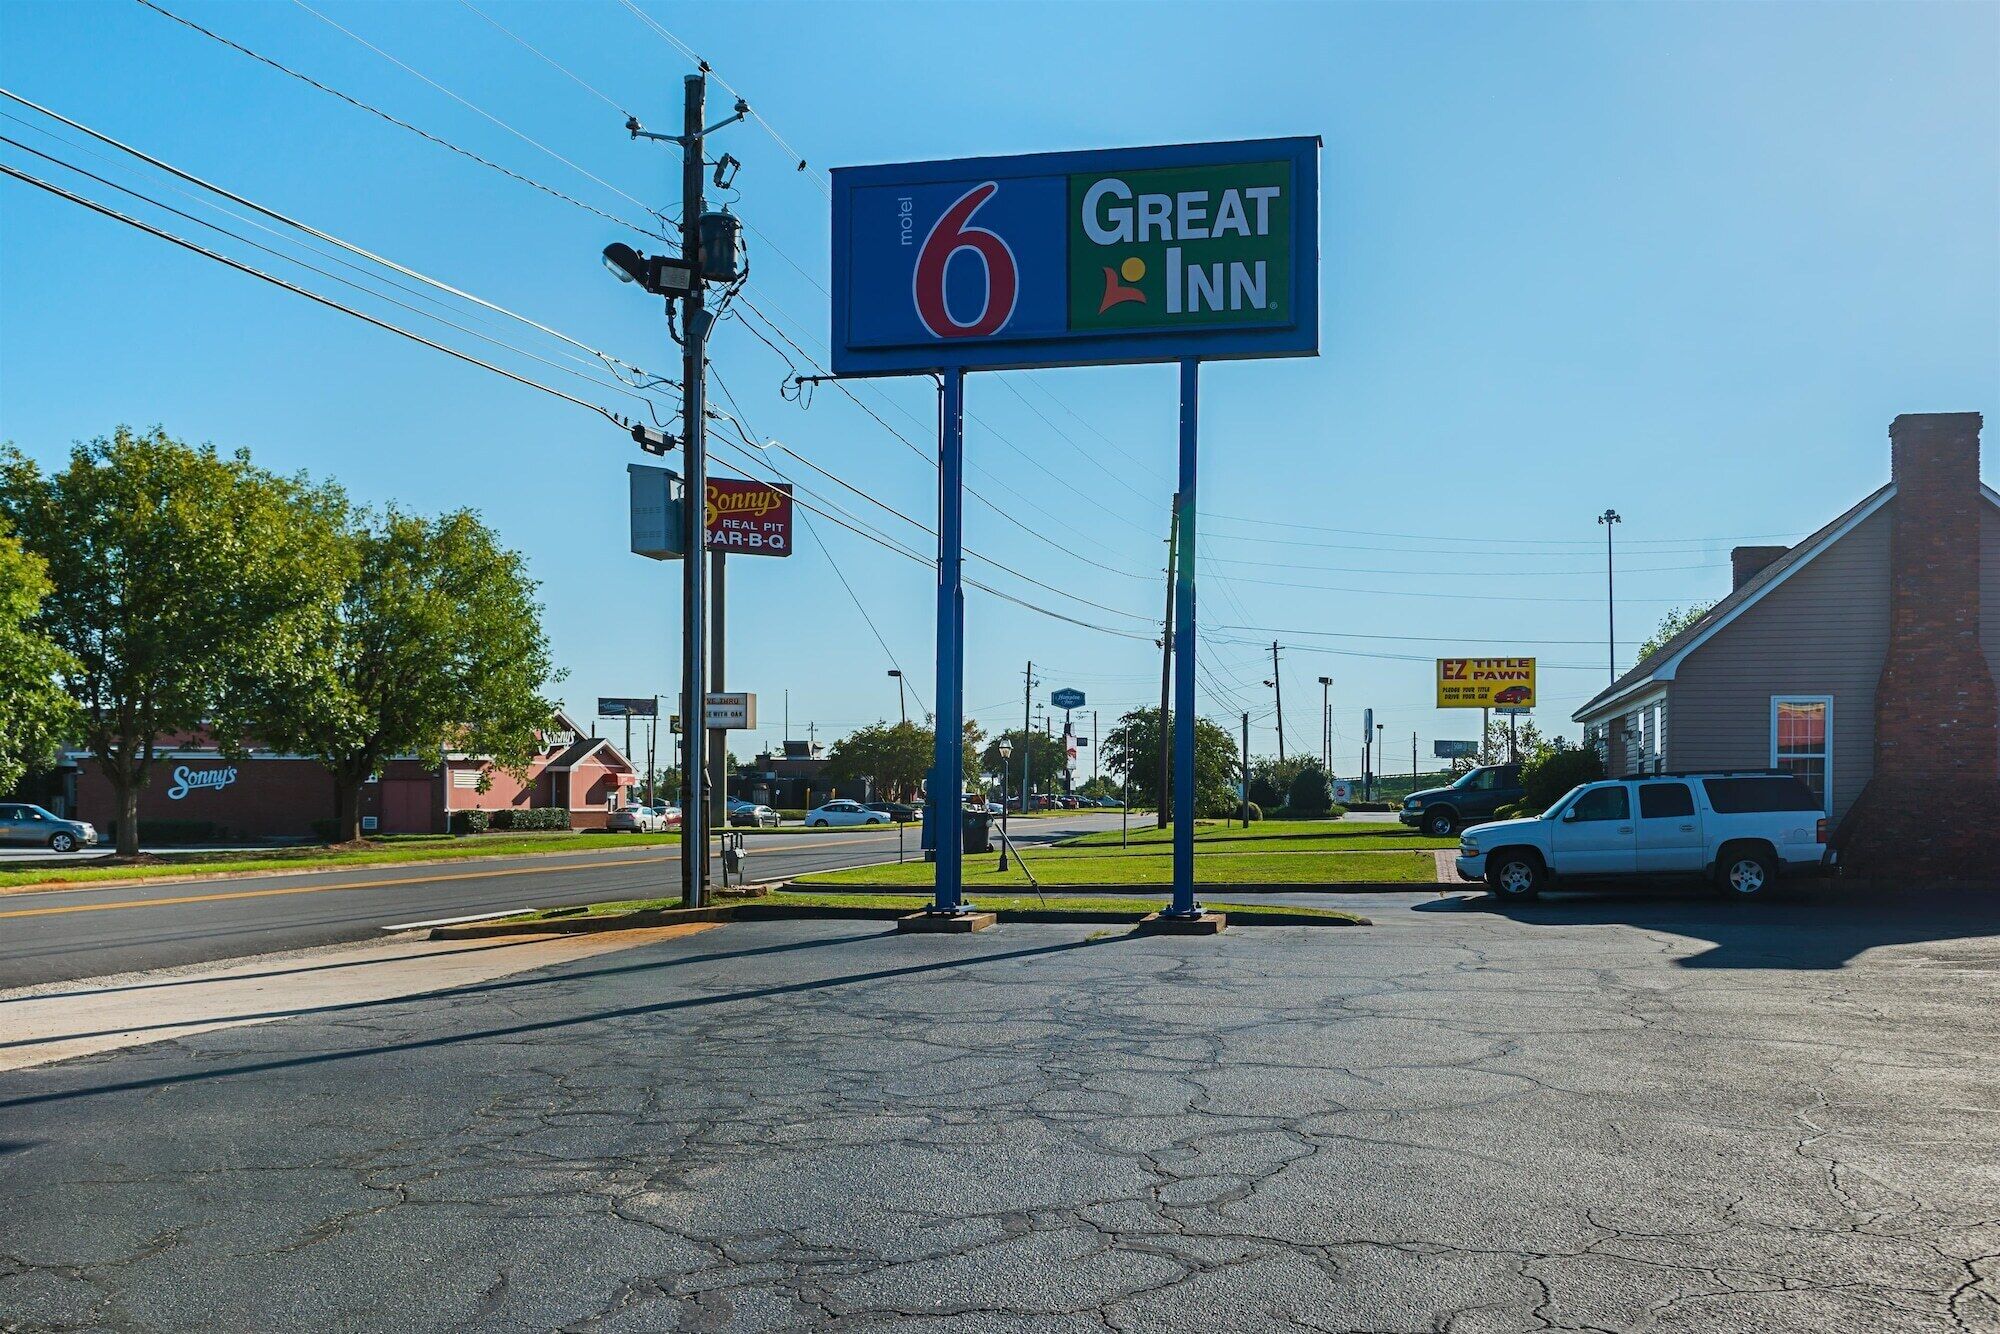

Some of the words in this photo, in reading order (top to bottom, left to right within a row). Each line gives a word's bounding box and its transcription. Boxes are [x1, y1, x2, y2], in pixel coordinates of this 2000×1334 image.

[1081, 178, 1281, 246] GREAT
[897, 197, 913, 246] motel
[912, 181, 1020, 339] 6
[1165, 246, 1268, 314] INN
[722, 519, 759, 531] REAL
[763, 522, 785, 533] PIT
[1442, 660, 1468, 680] EZ
[1473, 659, 1530, 668] TITLE
[1473, 671, 1530, 680] PAWN
[167, 765, 238, 800] Sonny's
